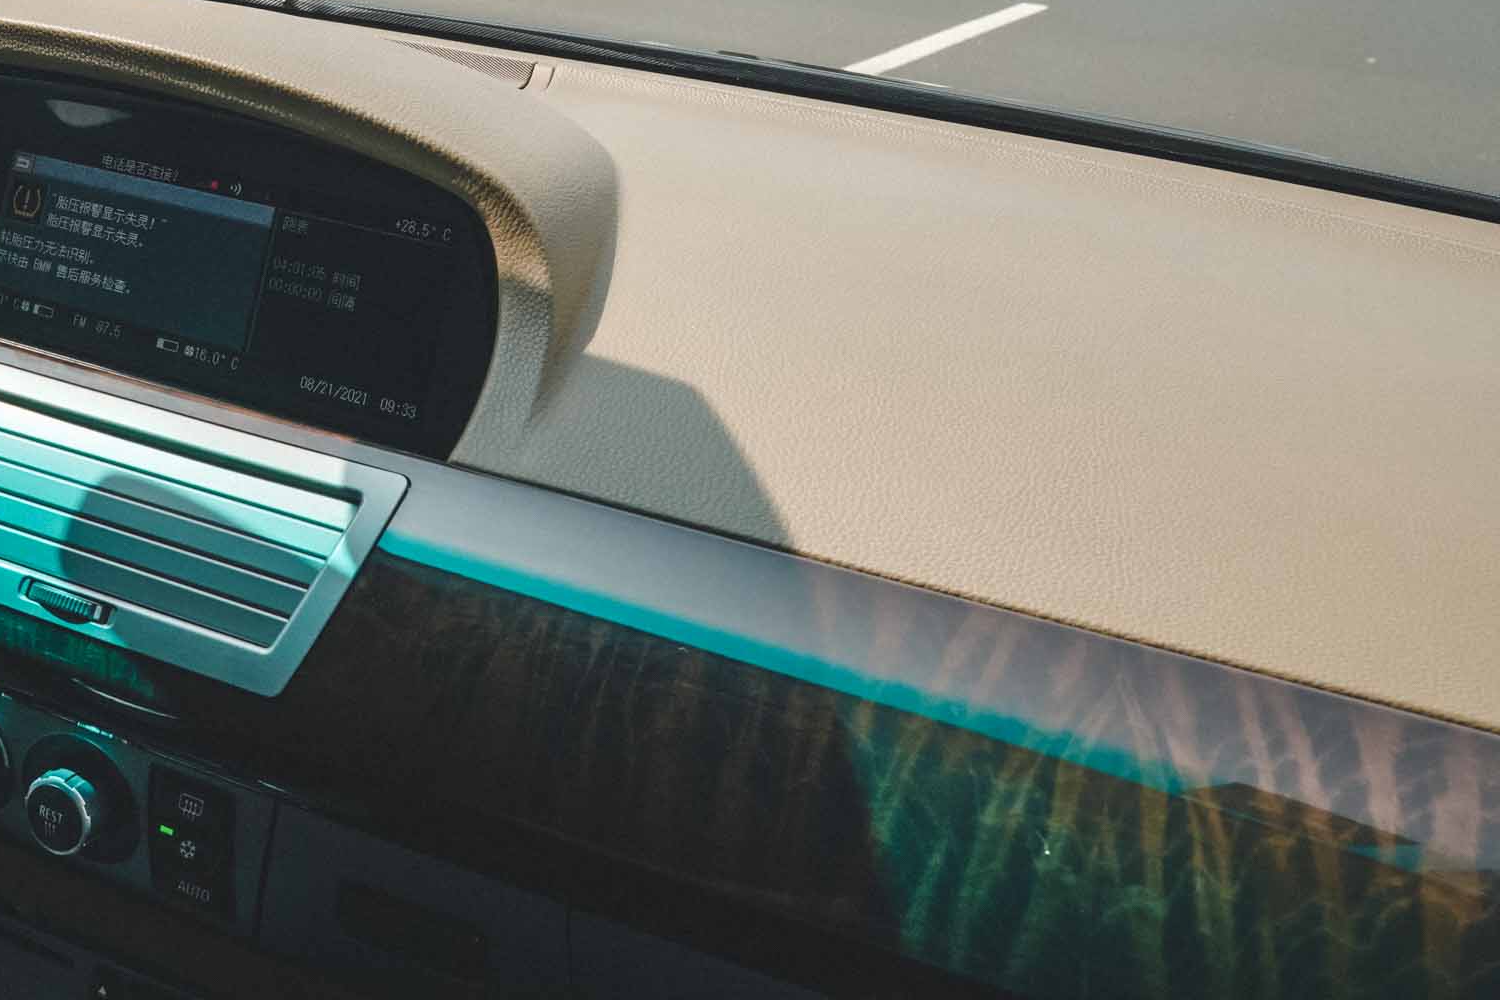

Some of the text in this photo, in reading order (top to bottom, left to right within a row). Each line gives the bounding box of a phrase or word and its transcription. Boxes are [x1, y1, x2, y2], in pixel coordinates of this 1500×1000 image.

[299, 375, 418, 420] 08/21/2021 09:33
[38, 804, 64, 824] REST
[177, 879, 211, 903] AUTO
